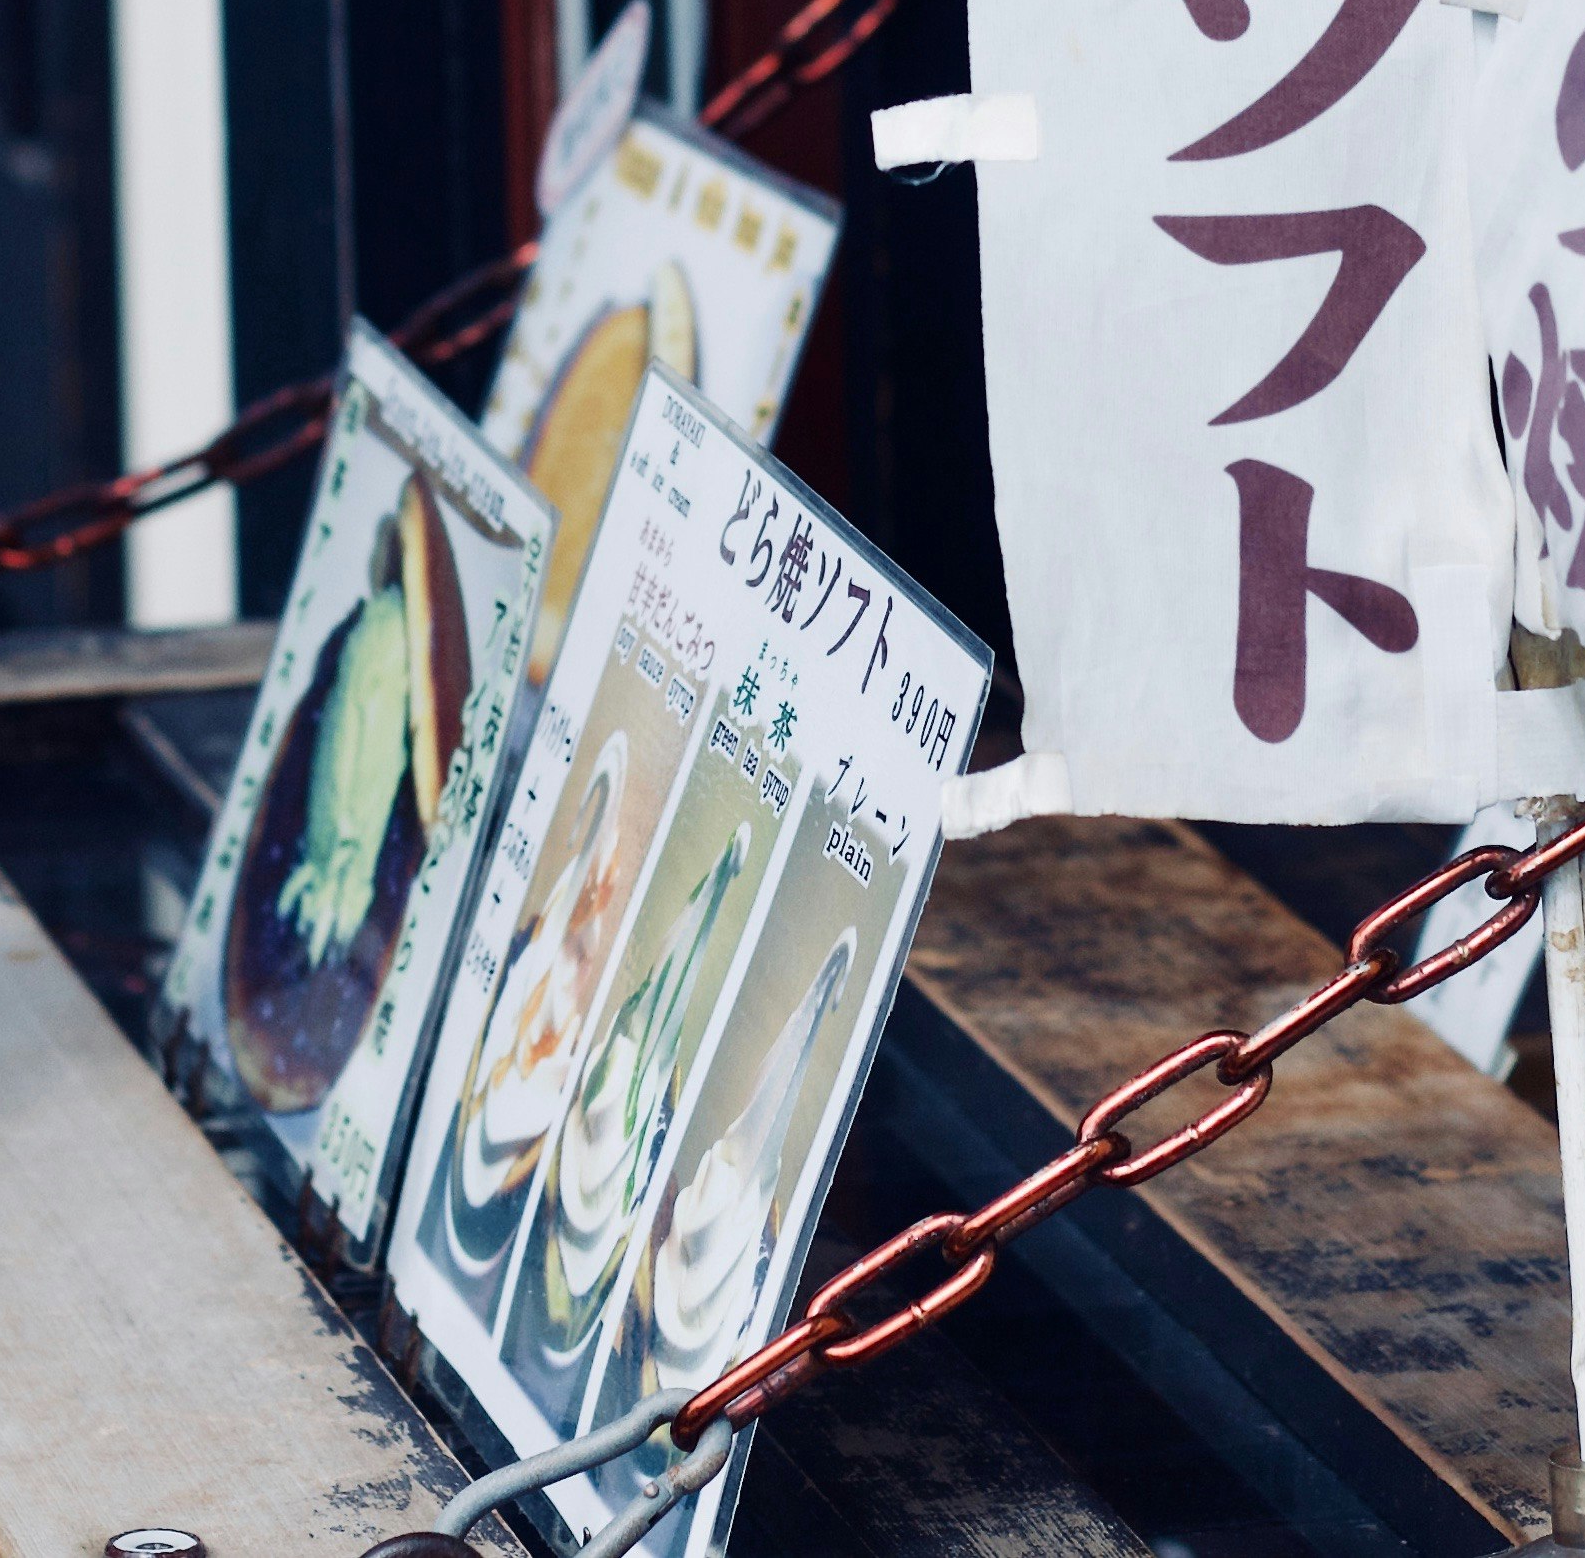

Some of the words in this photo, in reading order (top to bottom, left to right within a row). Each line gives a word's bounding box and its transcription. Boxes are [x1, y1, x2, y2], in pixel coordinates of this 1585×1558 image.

[662, 394, 706, 449] DORAYAKI
[719, 468, 892, 694] どら焼ソフト
[891, 671, 957, 772] 390円
[758, 639, 799, 691] まっちゃ
[617, 627, 636, 660] soy
[638, 648, 664, 684] sauce
[667, 677, 695, 720] syrup
[732, 664, 799, 752] 抹茶
[710, 719, 739, 759] green
[742, 746, 760, 778] tea
[762, 769, 791, 813] syrup
[827, 754, 912, 857] プレーン
[825, 826, 873, 882] plain
